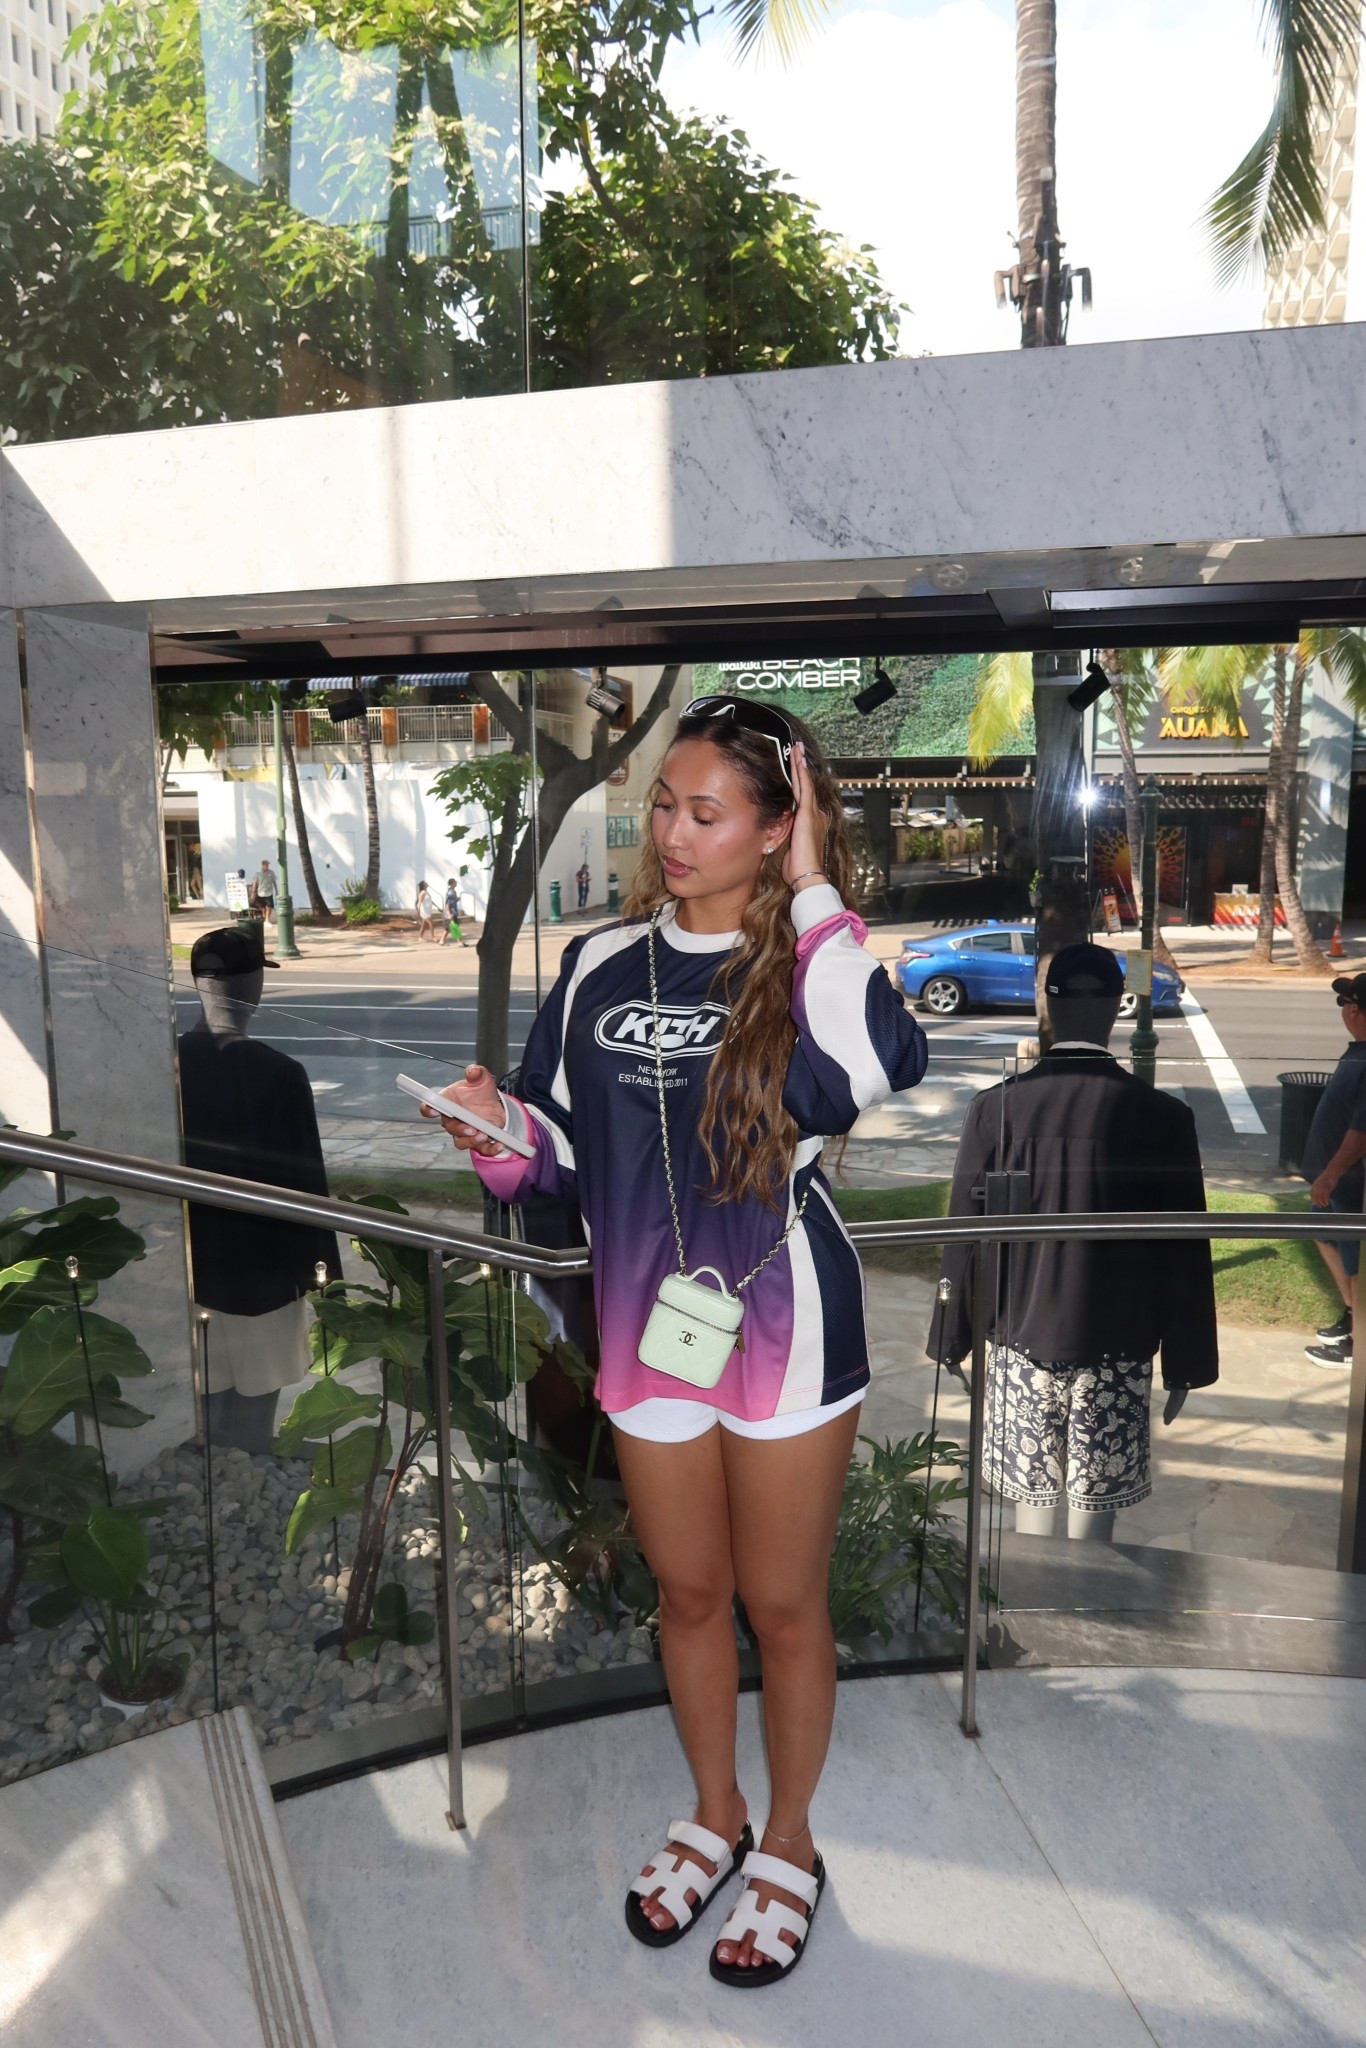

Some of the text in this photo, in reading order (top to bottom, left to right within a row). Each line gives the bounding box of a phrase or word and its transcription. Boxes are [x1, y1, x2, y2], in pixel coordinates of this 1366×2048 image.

[736, 670, 861, 690] COMBER
[613, 1011, 721, 1043] KITH
[638, 1065, 679, 1078] NEW YORK
[674, 1078, 688, 1087] 2011
